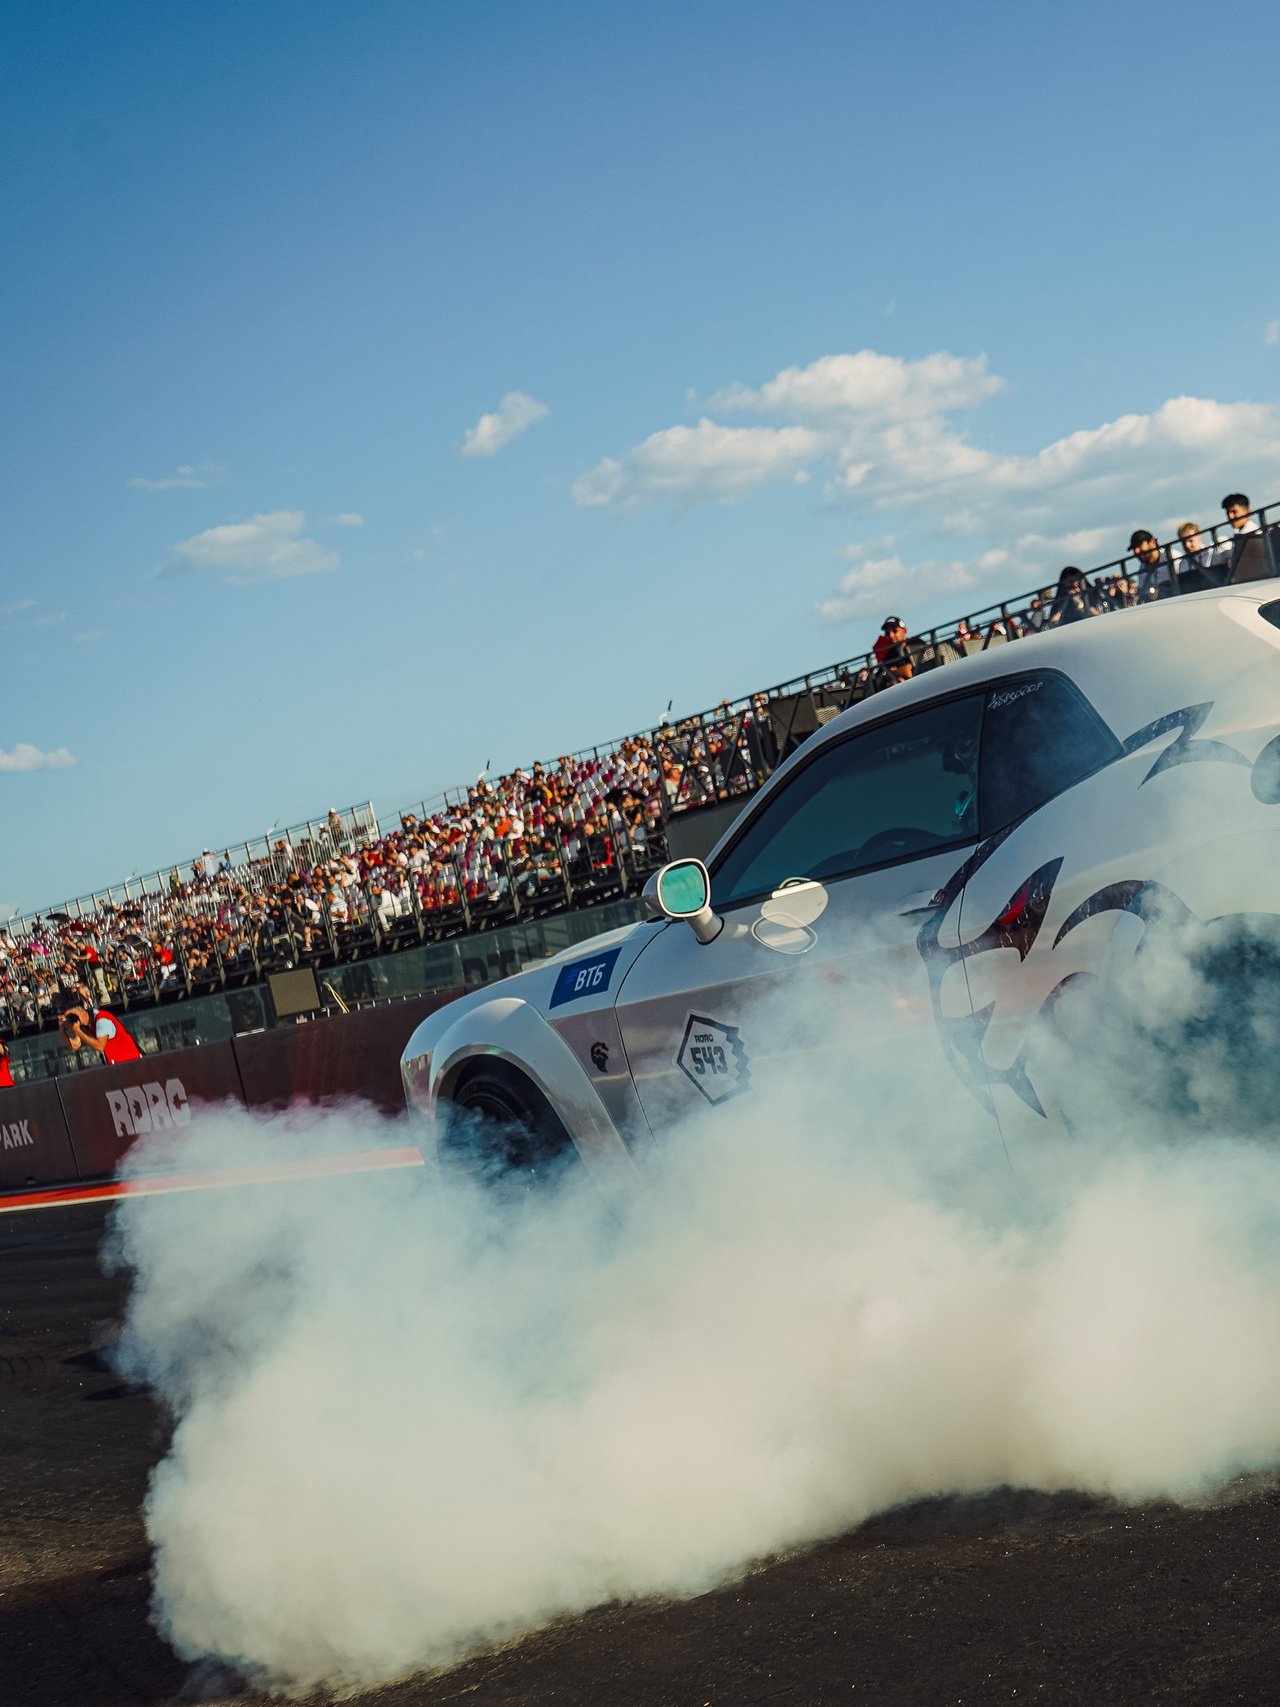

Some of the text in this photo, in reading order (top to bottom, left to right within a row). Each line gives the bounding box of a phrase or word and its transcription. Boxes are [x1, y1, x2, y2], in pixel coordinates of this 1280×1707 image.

[574, 963, 607, 992] ВТБ
[690, 1046, 729, 1075] 543
[105, 1078, 192, 1137] RDRC
[0, 1119, 34, 1150] ARK
